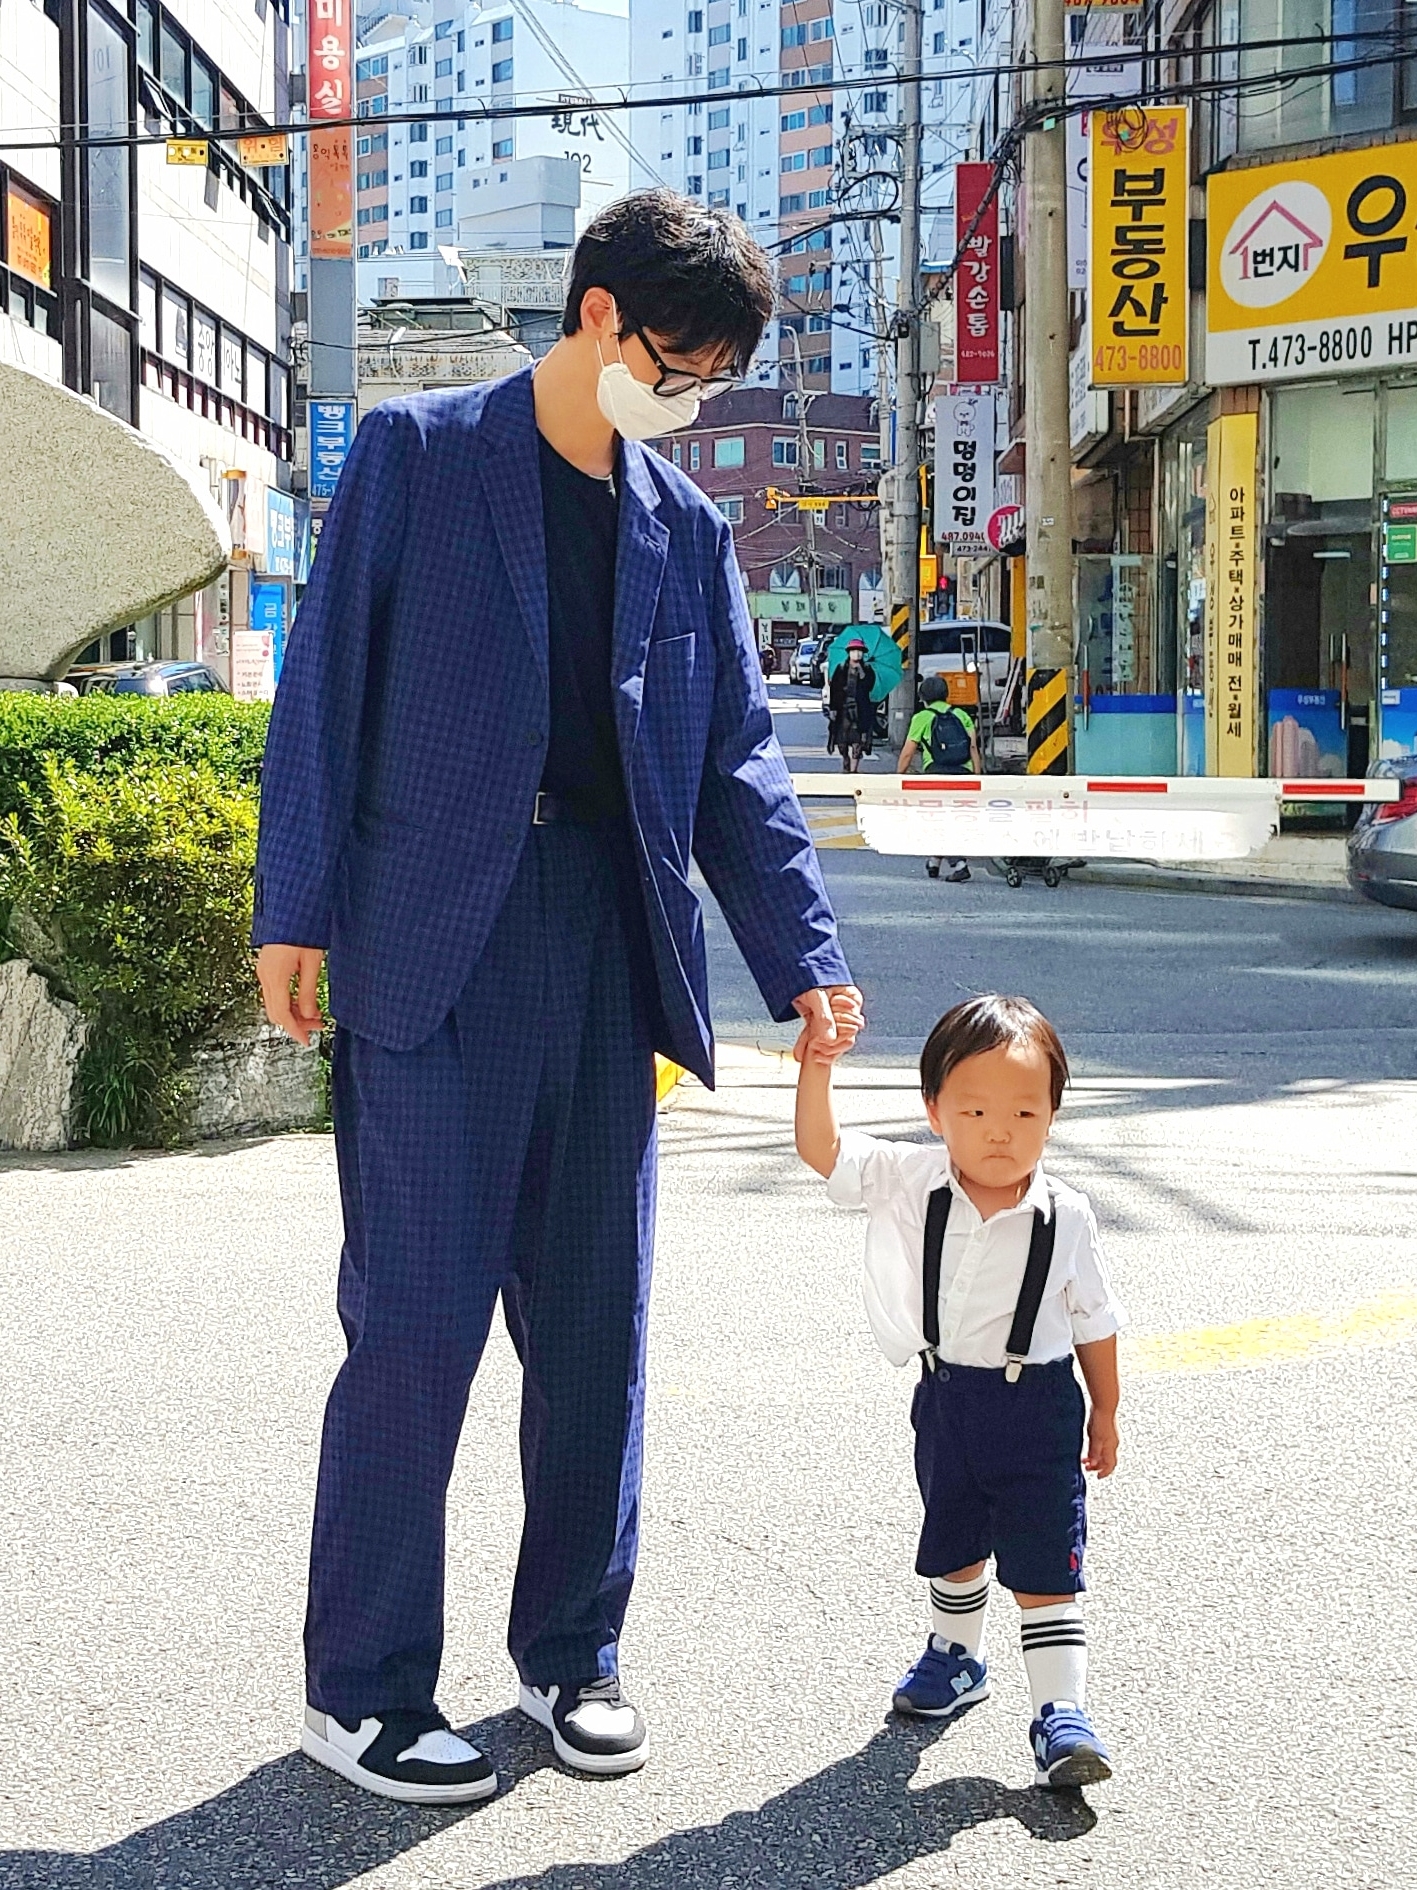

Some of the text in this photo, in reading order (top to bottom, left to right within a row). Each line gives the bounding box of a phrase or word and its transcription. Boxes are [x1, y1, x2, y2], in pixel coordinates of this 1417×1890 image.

[1101, 117, 1178, 156] 우성
[1108, 167, 1168, 337] 부동산
[1343, 174, 1417, 288] 우
[962, 234, 991, 337] 빨강손톱
[1094, 344, 1182, 371] 473-8800
[1248, 325, 1372, 371] T.473-8800
[952, 440, 977, 527] 멍멍이집
